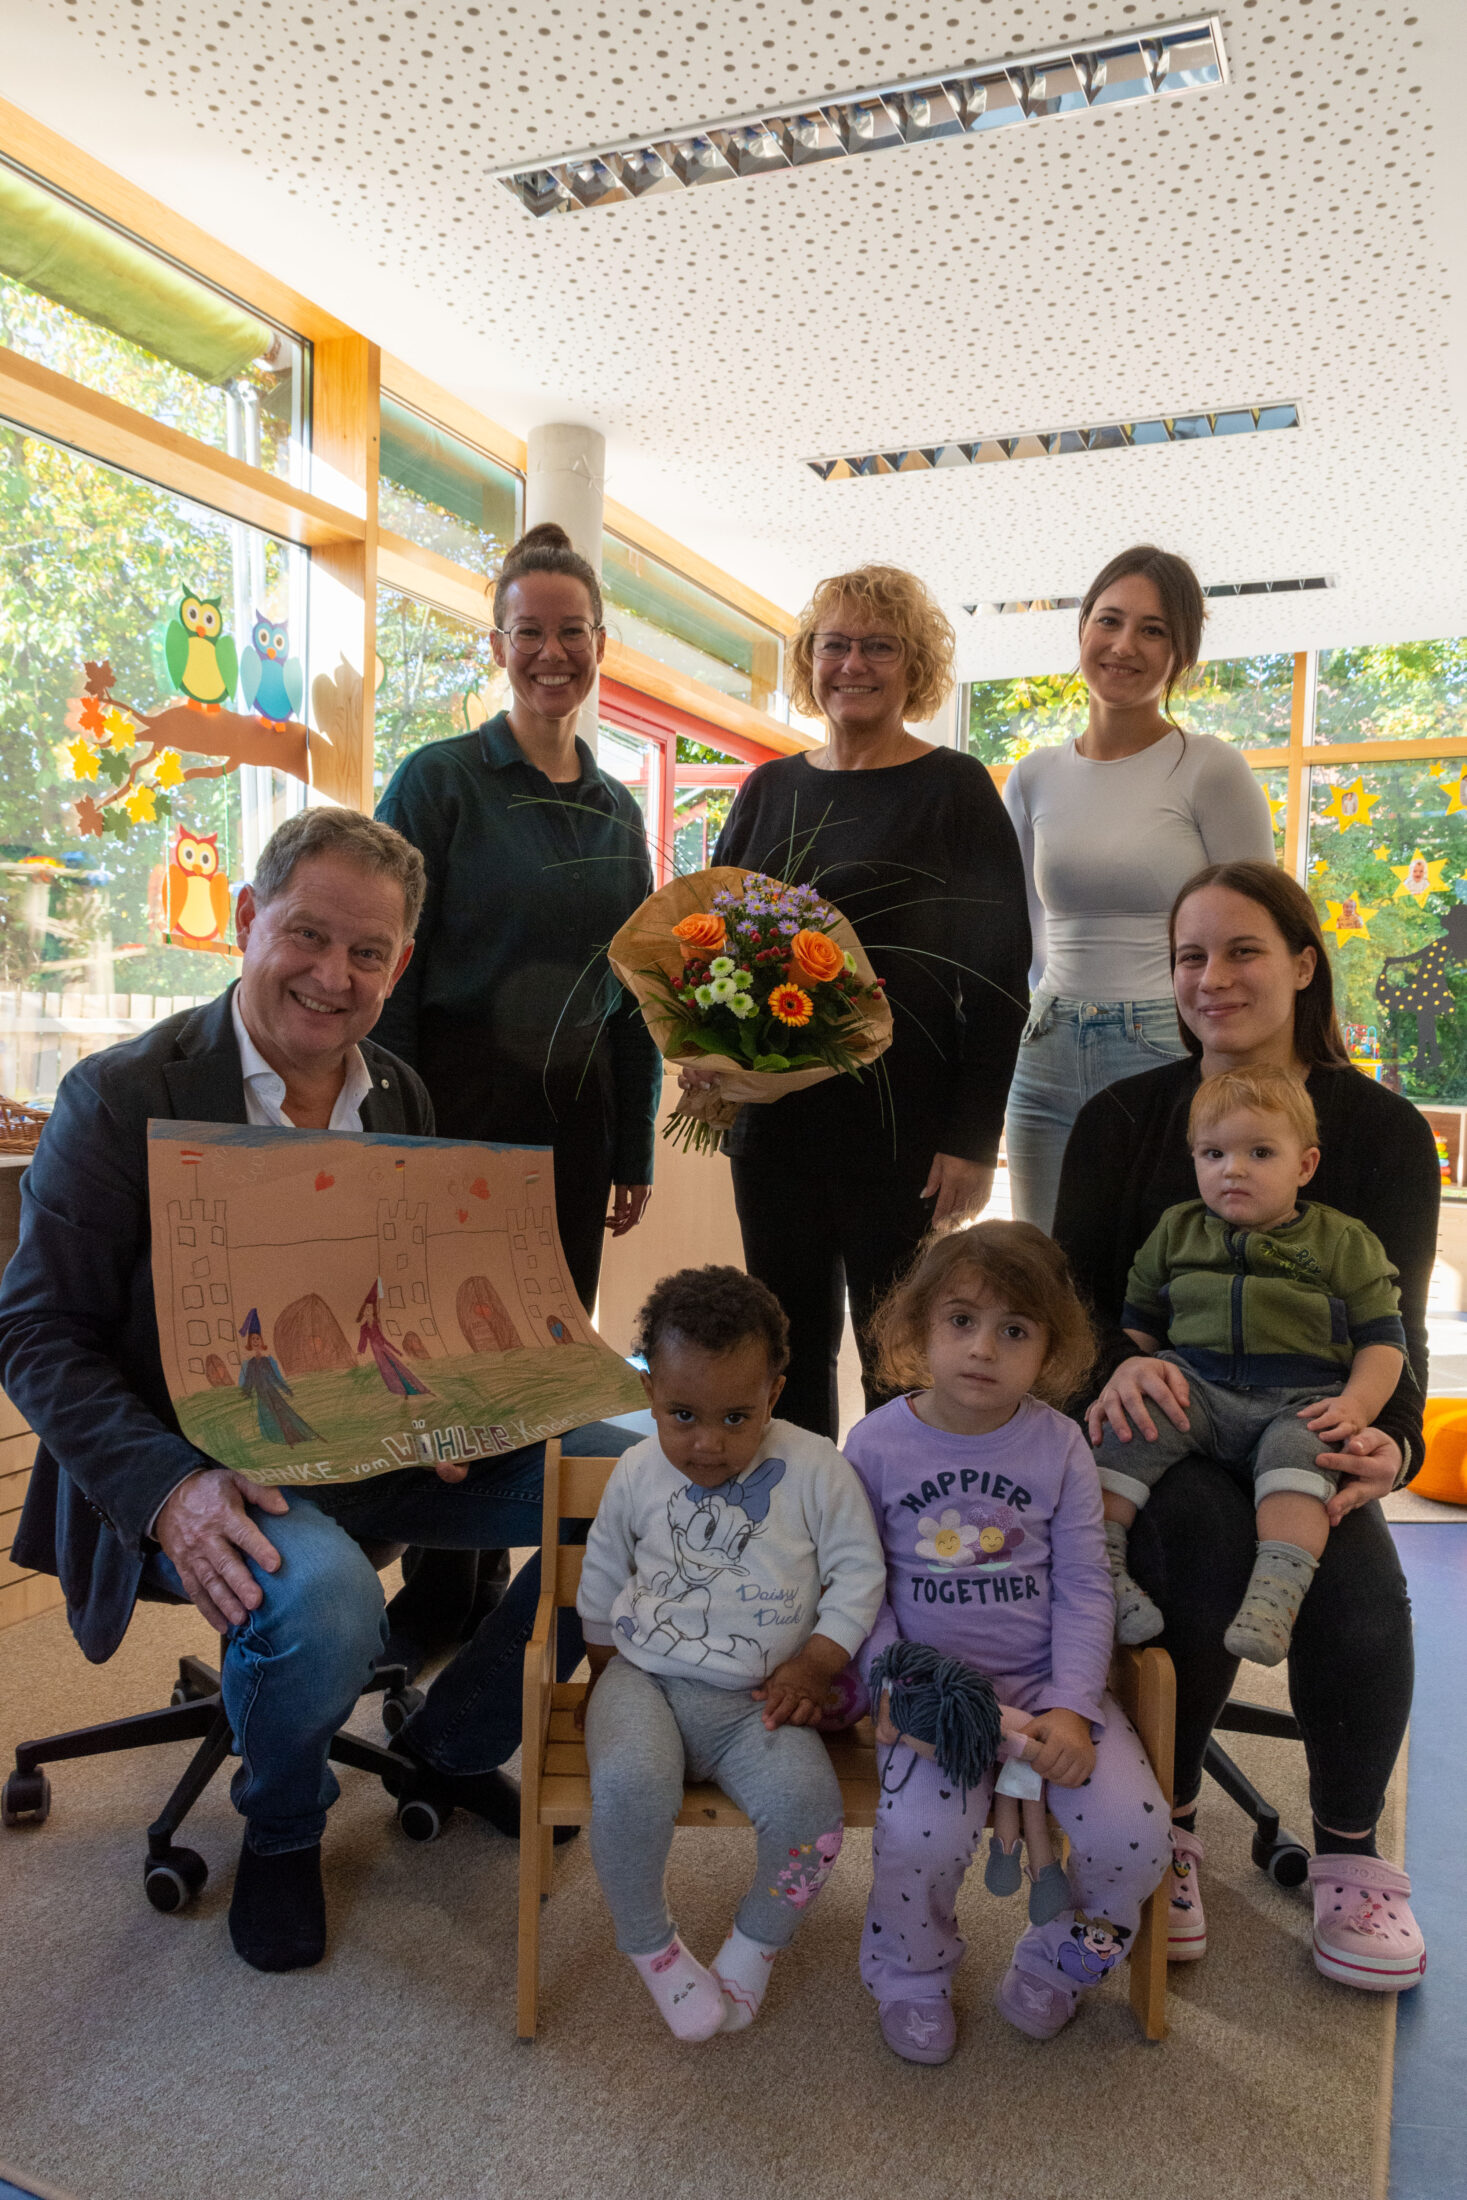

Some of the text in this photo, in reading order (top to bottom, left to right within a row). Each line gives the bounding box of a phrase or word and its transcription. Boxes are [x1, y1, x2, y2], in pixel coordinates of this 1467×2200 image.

[243, 1461, 340, 1483] DANKE
[350, 1458, 390, 1475] vom
[900, 1469, 1032, 1514] HAPPIER
[735, 1584, 800, 1609] Daisy
[911, 1575, 1040, 1604] TOGETHER
[752, 1604, 803, 1628] Duck
